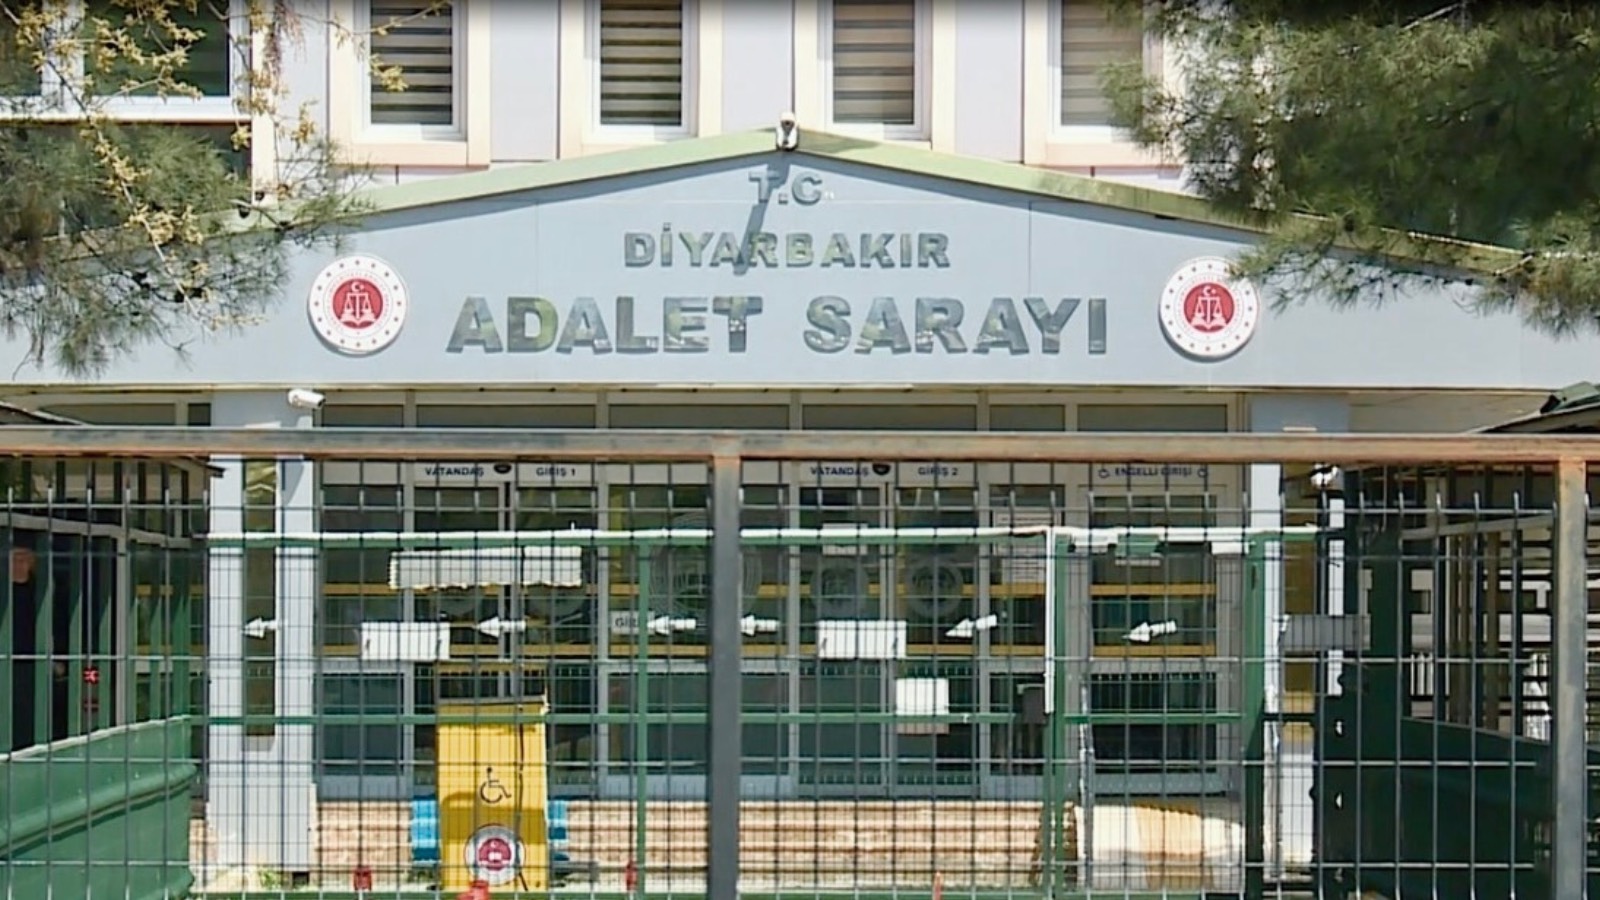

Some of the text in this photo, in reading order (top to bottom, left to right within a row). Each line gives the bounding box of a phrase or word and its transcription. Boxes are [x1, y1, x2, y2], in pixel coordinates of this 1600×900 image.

[623, 222, 951, 268] DİYARBAKIR
[445, 295, 763, 354] ADALET
[803, 295, 1108, 354] SARAYI
